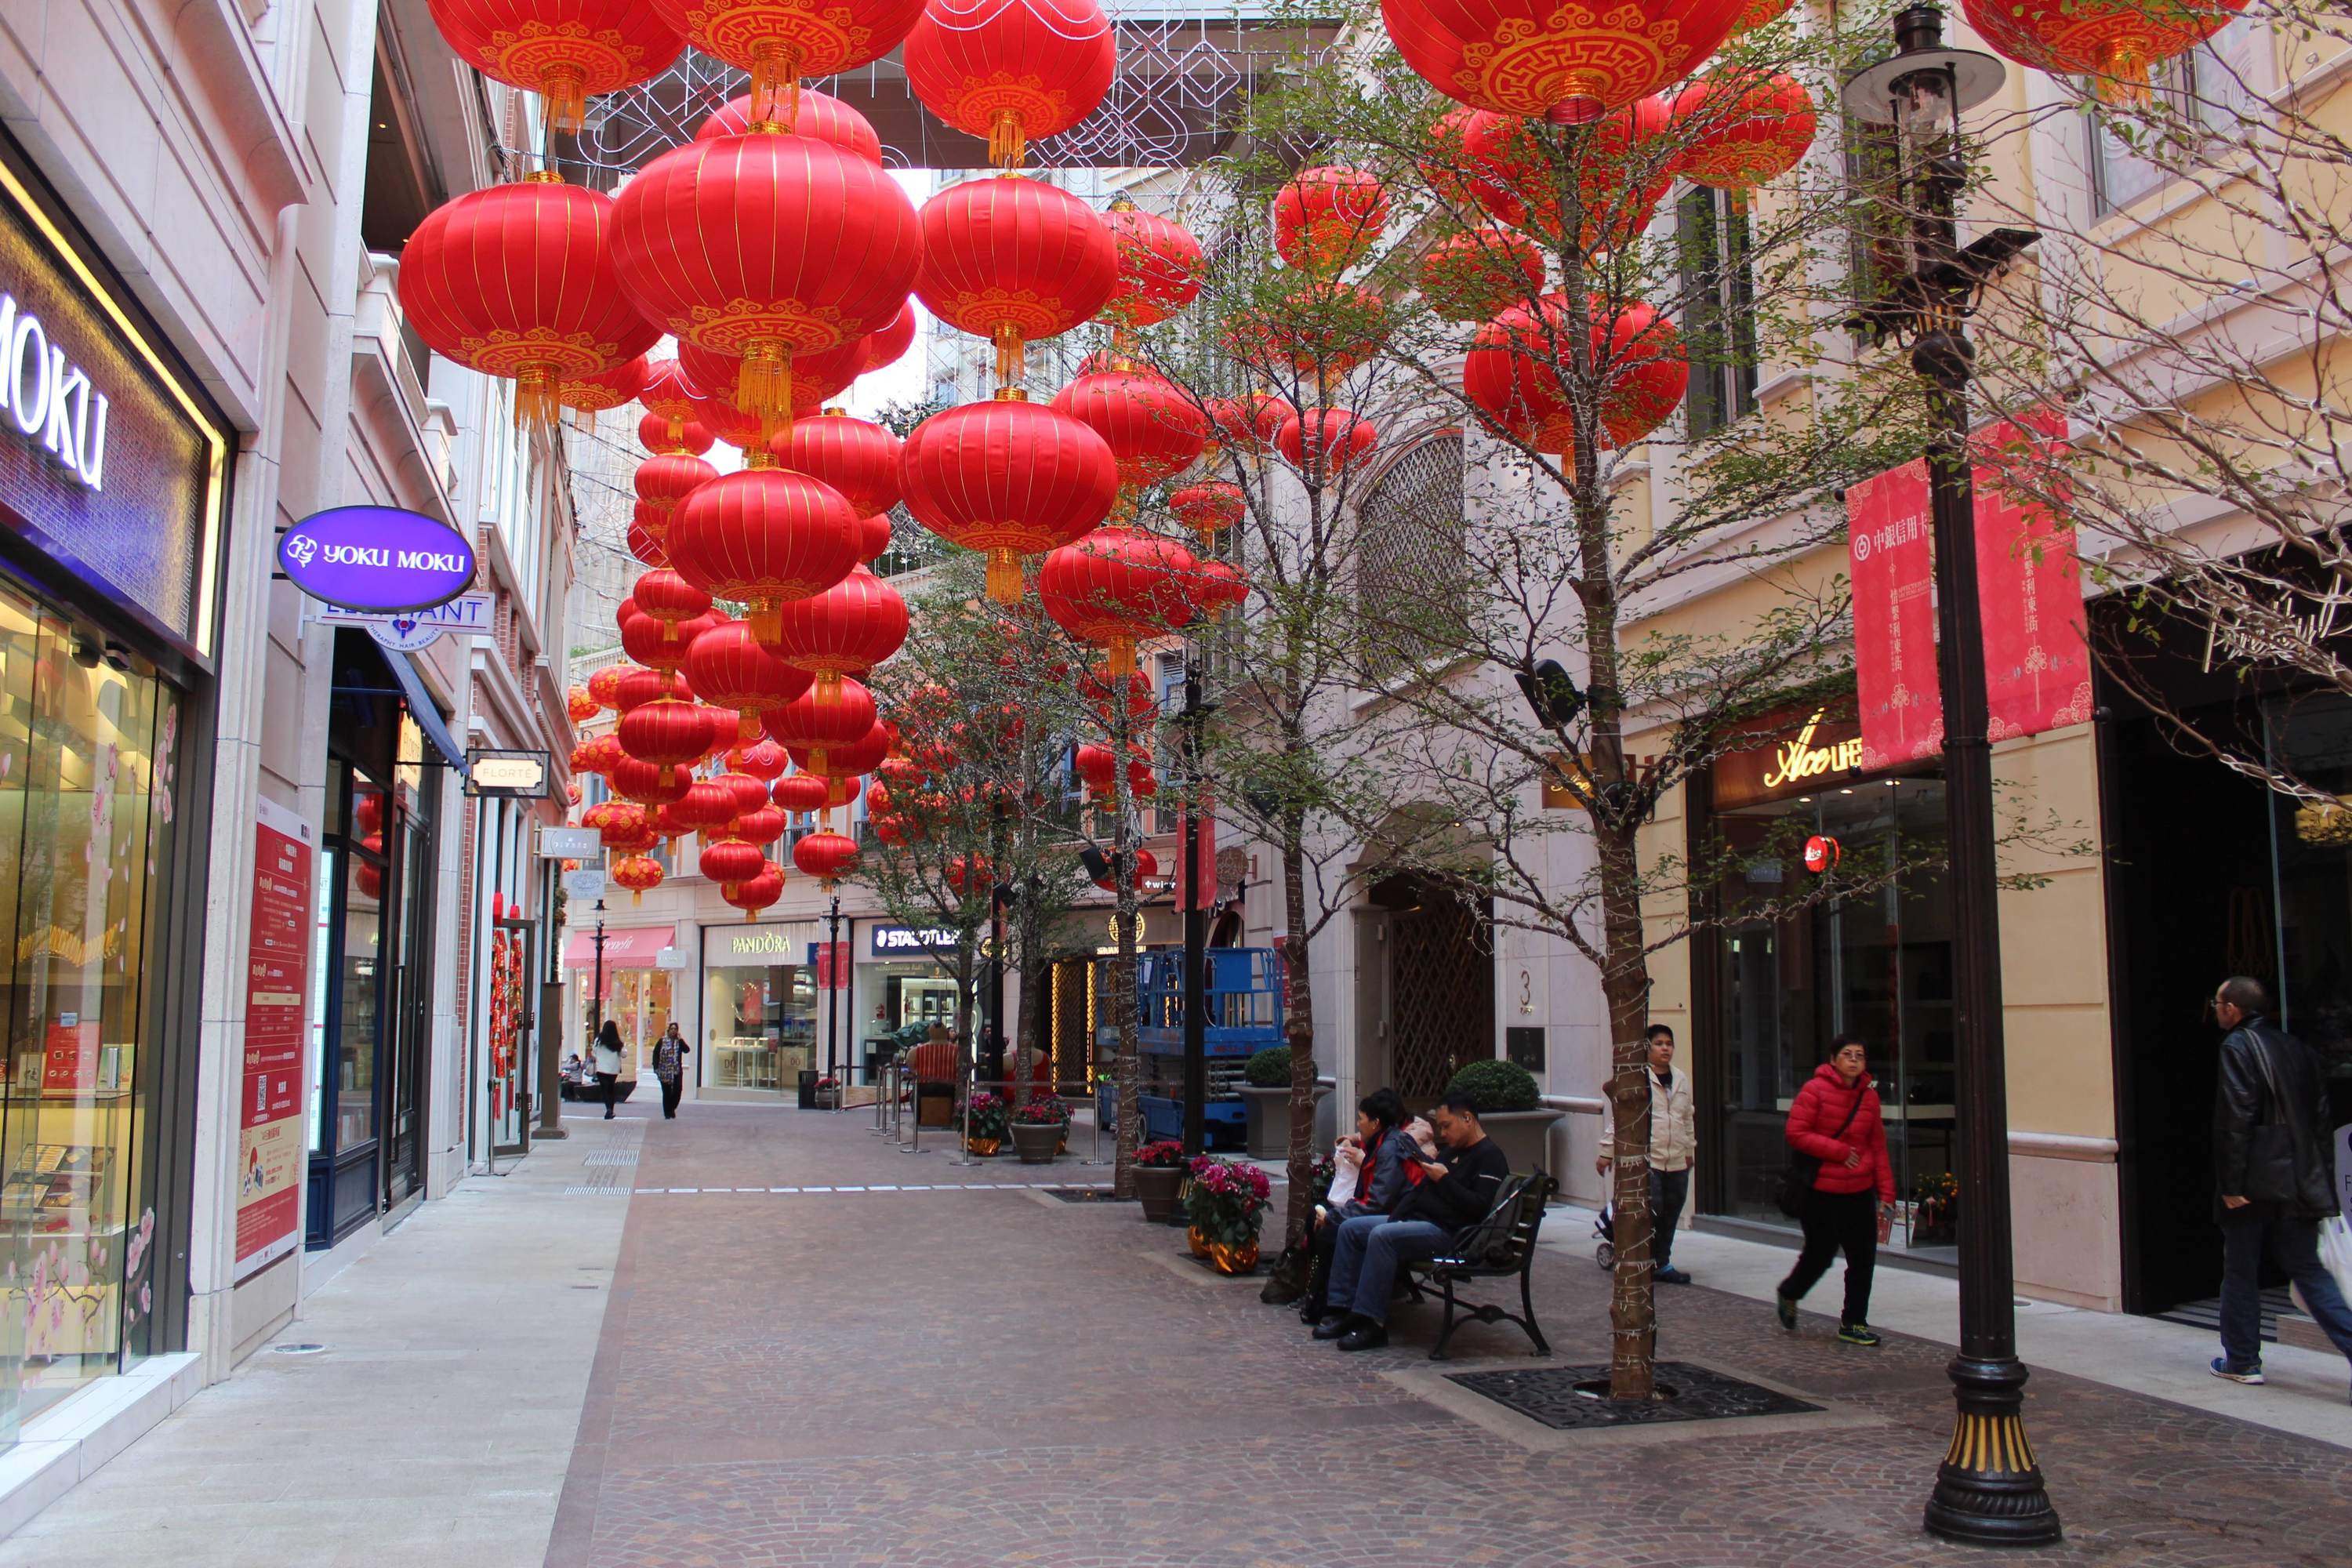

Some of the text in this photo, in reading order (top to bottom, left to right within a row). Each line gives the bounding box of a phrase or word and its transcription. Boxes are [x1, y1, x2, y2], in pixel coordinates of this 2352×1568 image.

[1873, 511, 1928, 554] 中銀信用卡
[323, 544, 466, 572] YOKU MOKU
[482, 767, 533, 779] FLORTÉ
[1145, 880, 1176, 889] twi
[731, 933, 791, 954] PANDORA
[1519, 970, 1530, 1006] 3
